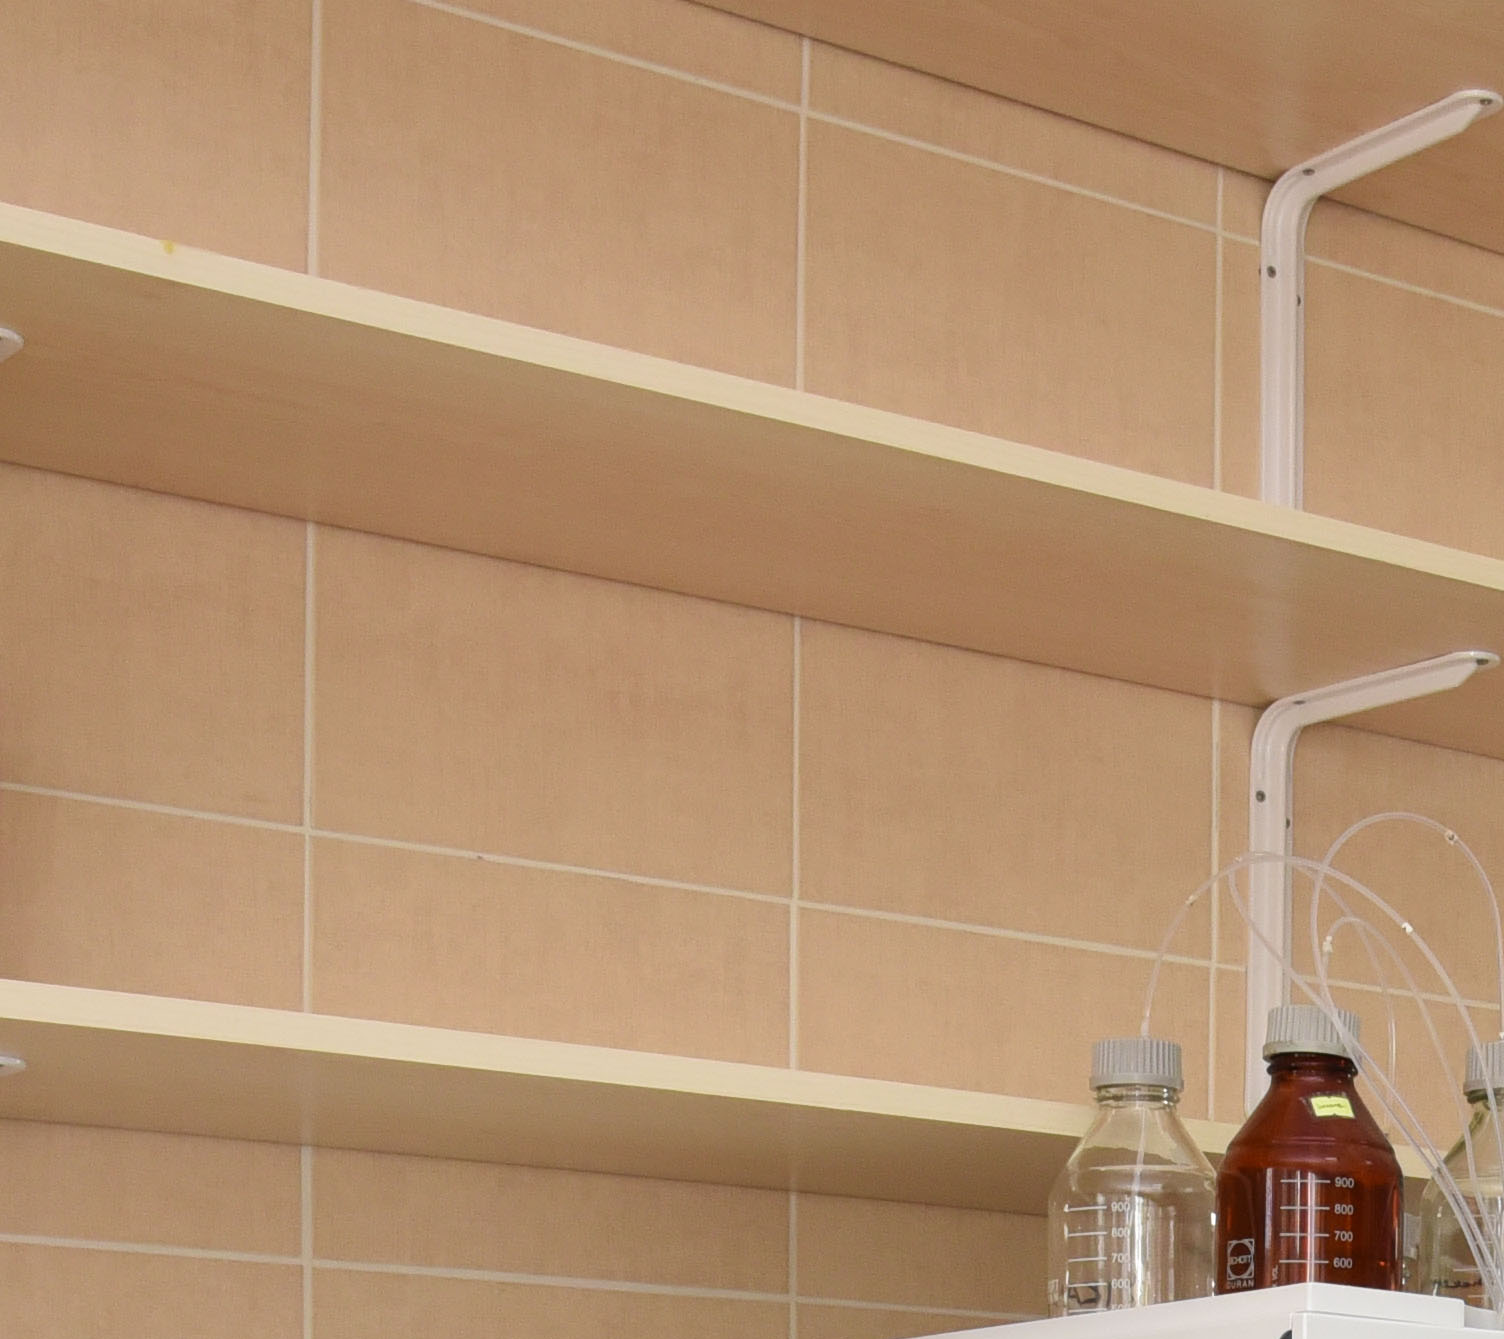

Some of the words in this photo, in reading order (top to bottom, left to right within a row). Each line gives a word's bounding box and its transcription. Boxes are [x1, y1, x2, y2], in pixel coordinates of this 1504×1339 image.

[1333, 1176, 1355, 1189] 900
[1111, 1201, 1130, 1213] 900
[1333, 1203, 1354, 1216] 800
[1111, 1227, 1130, 1238] 800
[1333, 1230, 1354, 1243] 700
[1111, 1253, 1130, 1263] 700
[1332, 1257, 1354, 1270] 600
[1111, 1278, 1130, 1290] 600
